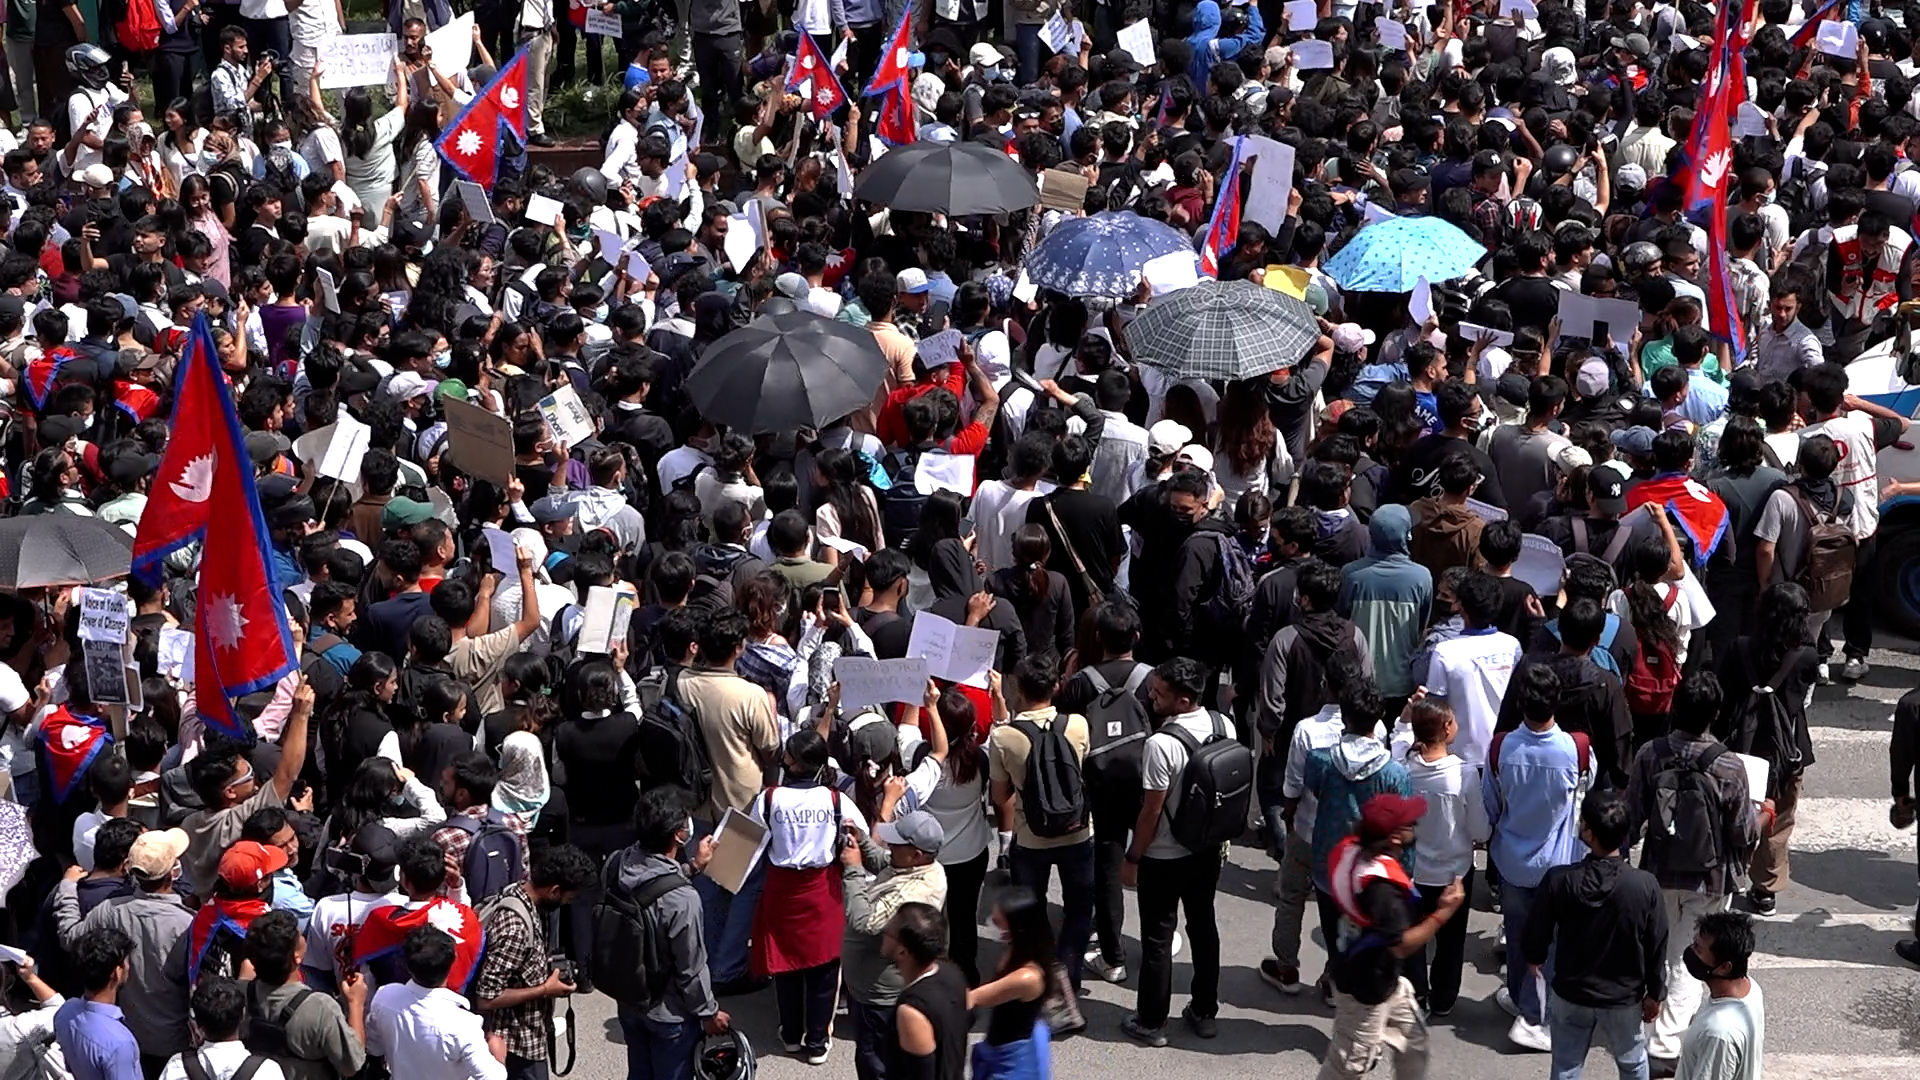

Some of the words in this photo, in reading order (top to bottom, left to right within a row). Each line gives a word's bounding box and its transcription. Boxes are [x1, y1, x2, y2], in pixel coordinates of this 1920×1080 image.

[1414, 405, 1438, 427] AME
[85, 594, 99, 610] Voice
[80, 612, 98, 628] Power
[105, 616, 127, 635] Change
[774, 809, 835, 824] CAMPION
